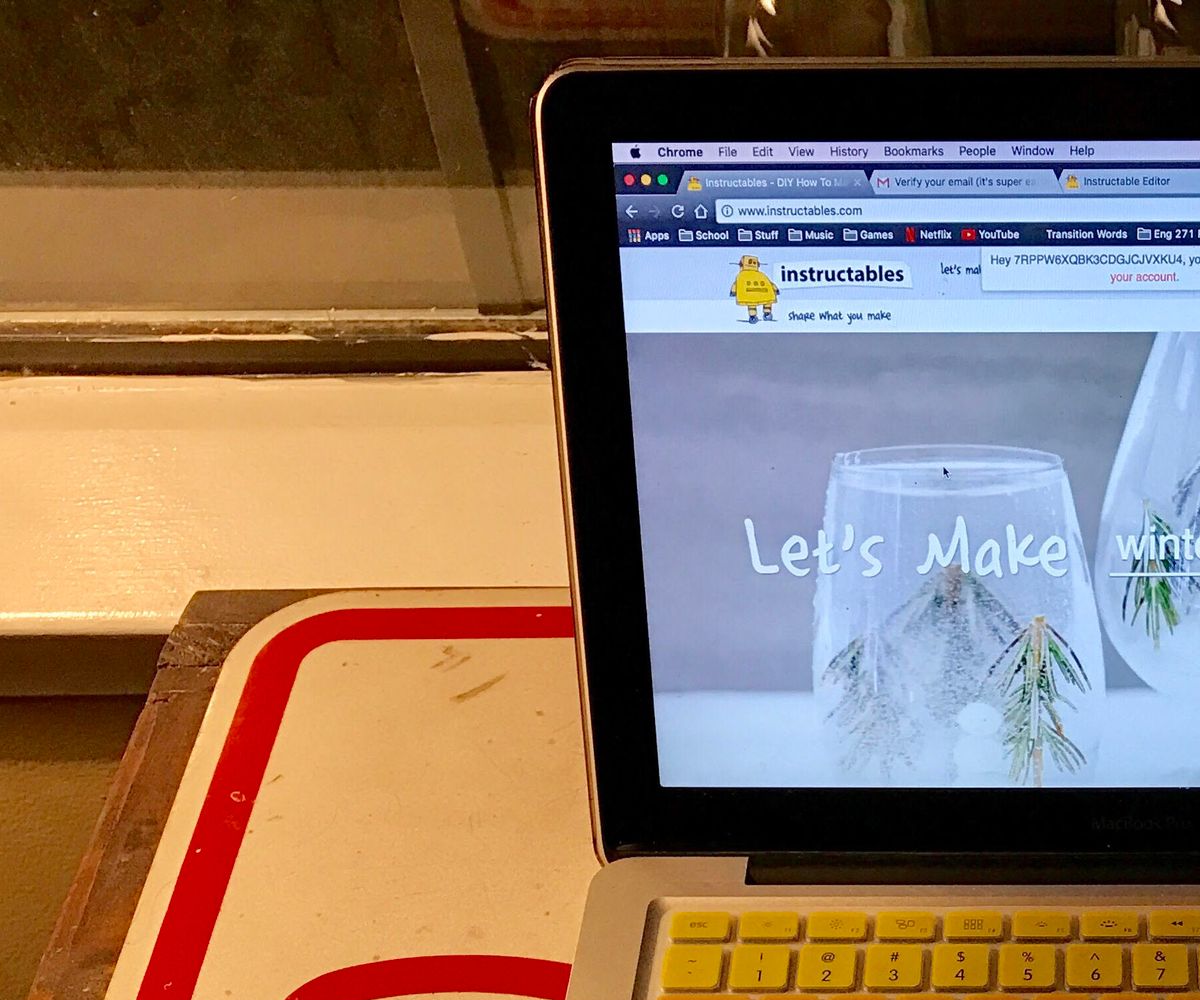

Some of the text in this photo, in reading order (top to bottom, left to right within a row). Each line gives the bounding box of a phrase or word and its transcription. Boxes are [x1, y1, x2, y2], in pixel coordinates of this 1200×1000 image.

[658, 145, 1095, 159] Chrome File Edit View History Bookmarks People Window Help
[705, 177, 767, 188] Instructables
[777, 177, 794, 188] DIY
[796, 177, 818, 188] How
[819, 177, 832, 188] To
[894, 176, 924, 189] Verify
[926, 179, 946, 189] your
[948, 176, 974, 188] email
[976, 176, 993, 189] (it's
[996, 179, 1022, 189] super
[1084, 176, 1170, 187] Instructable Editor
[738, 205, 862, 217] www.instructables.com
[644, 230, 670, 242] Apps
[696, 230, 729, 240] School
[755, 229, 779, 240] Stuff
[804, 230, 834, 240] Music
[860, 230, 894, 240] Games
[920, 229, 952, 240] Netflix
[978, 229, 1020, 240] YouTube
[1046, 229, 1128, 240] Transition Words
[1154, 229, 1173, 242] Eng
[1175, 229, 1194, 240] 271
[990, 254, 1012, 267] Hey
[780, 266, 904, 284] instructables
[940, 262, 962, 276] let's
[1110, 272, 1180, 284] your account.
[788, 310, 892, 324] share what you make
[744, 514, 1068, 578] Let's Make
[689, 920, 708, 929] esc
[756, 968, 762, 982] 1
[822, 968, 832, 982] 2
[888, 968, 899, 982] 3
[954, 968, 966, 982] 4
[1024, 968, 1032, 982] 5
[1090, 968, 1100, 982] 6
[1156, 968, 1166, 982] 7
